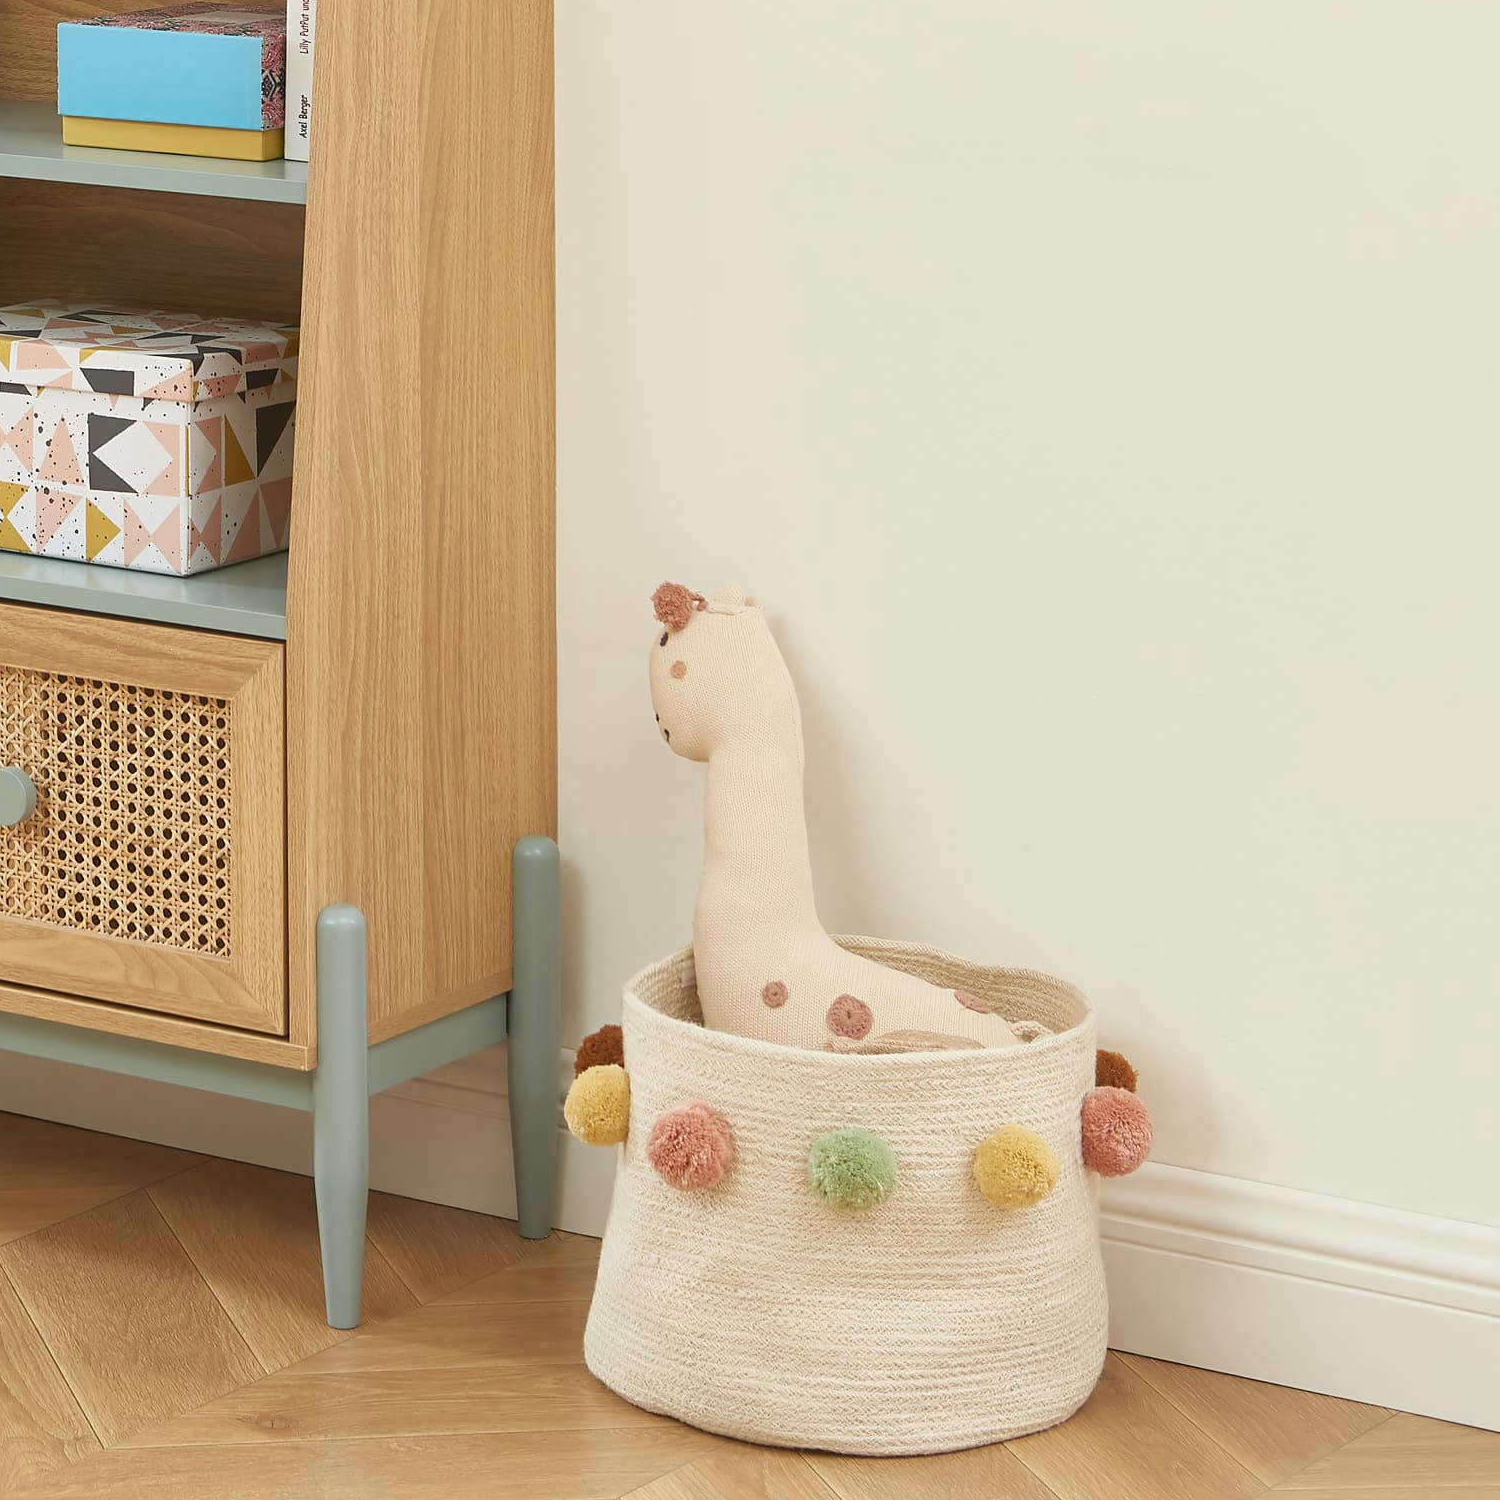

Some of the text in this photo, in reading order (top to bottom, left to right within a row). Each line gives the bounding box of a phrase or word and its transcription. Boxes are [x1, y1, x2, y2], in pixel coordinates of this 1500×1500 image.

[300, 13, 309, 37] PutPut
[300, 39, 311, 54] Lilly
[298, 94, 311, 138] Axel Berger
